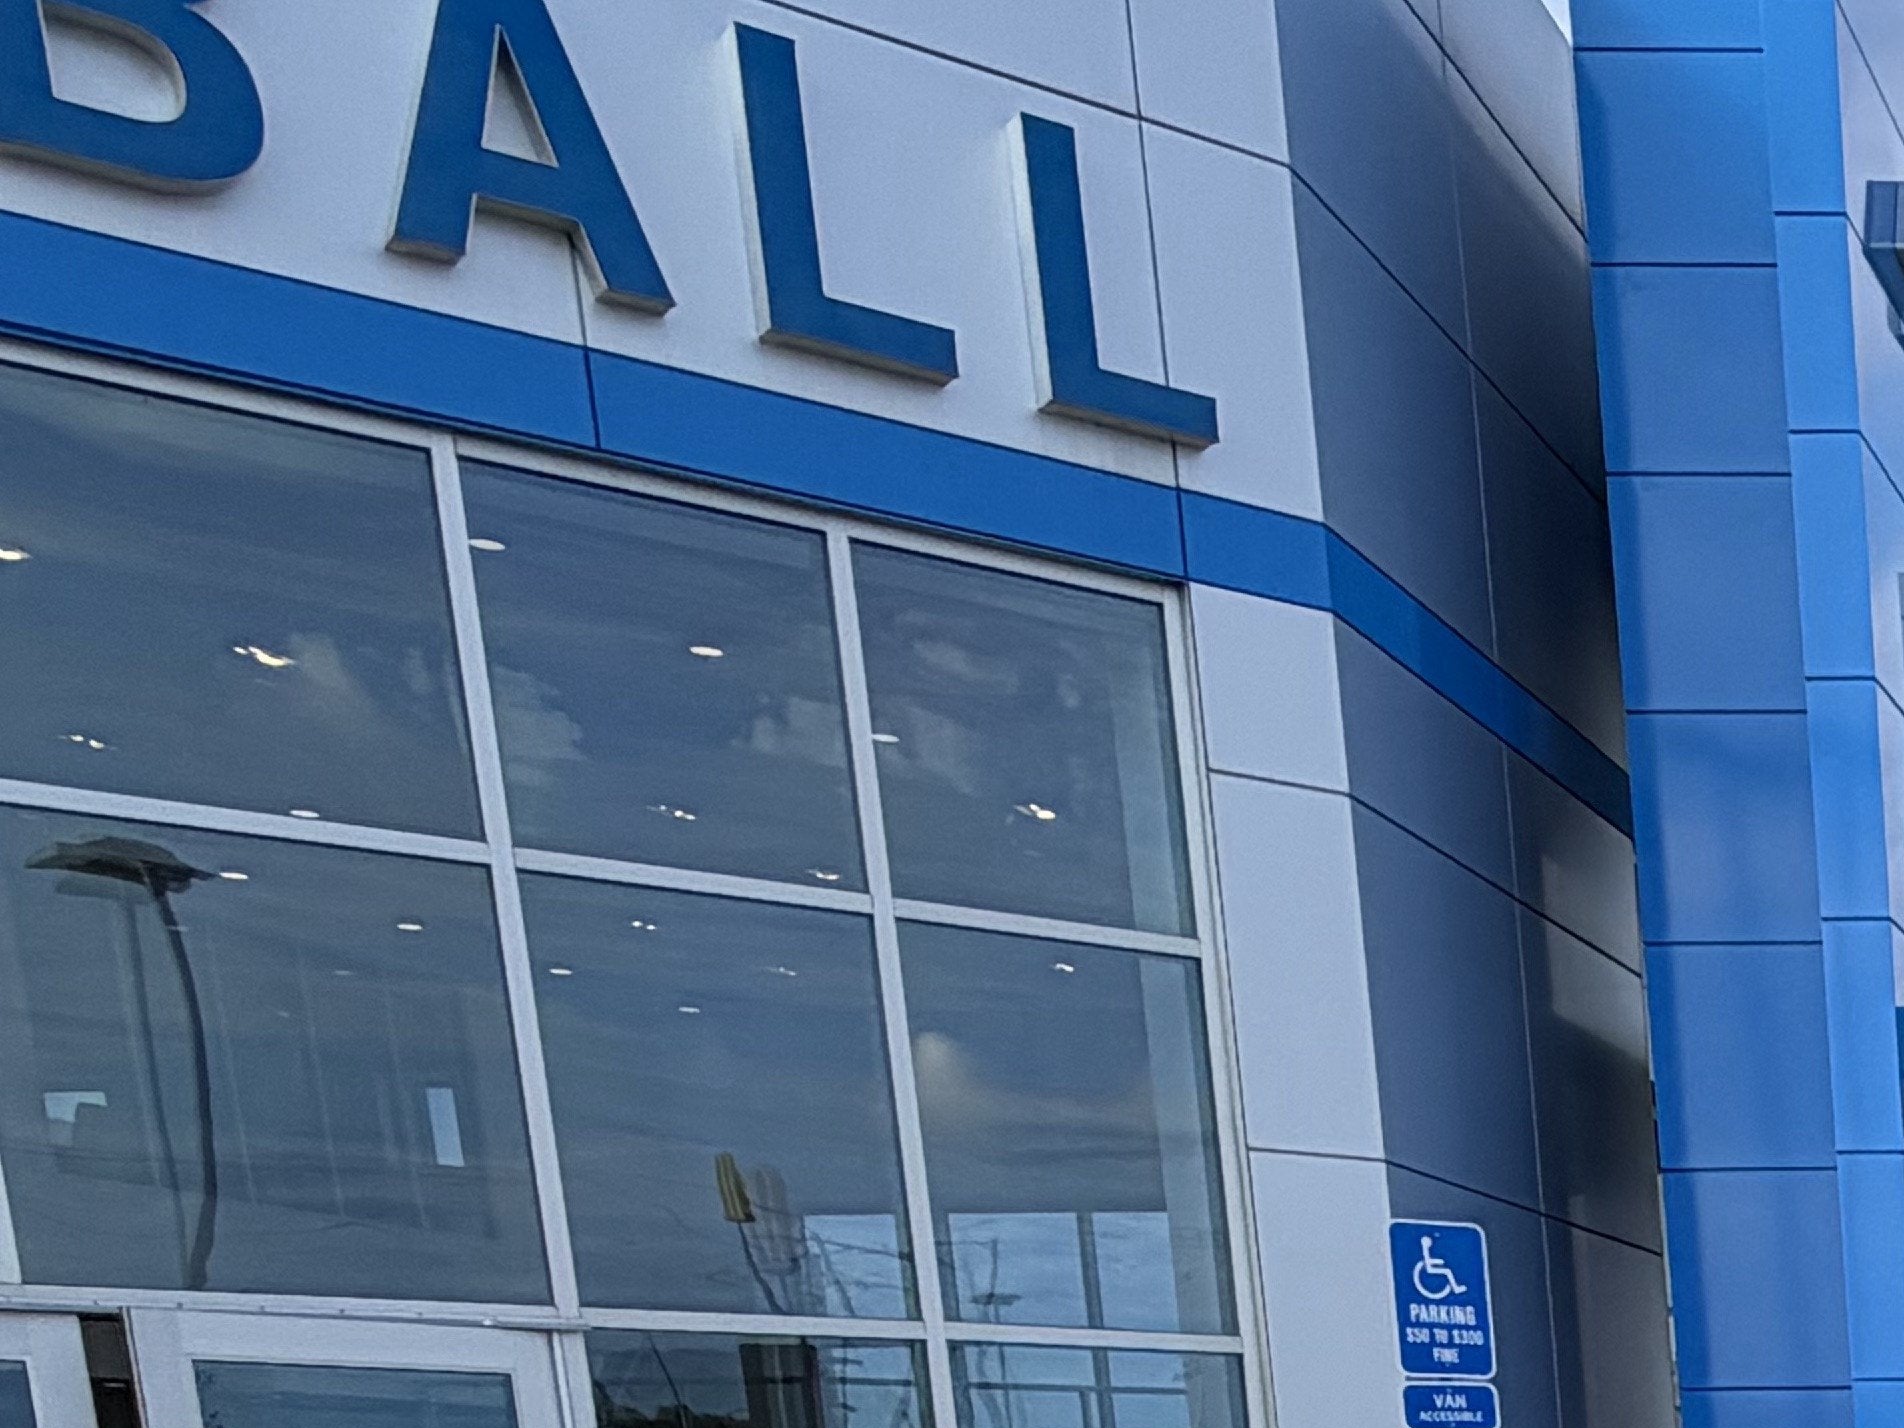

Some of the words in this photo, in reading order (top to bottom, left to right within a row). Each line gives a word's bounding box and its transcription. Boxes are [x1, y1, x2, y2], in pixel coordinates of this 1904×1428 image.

[1409, 1303, 1477, 1326] PARKING
[1433, 1328, 1449, 1344] TO
[1433, 1347, 1460, 1364] FINE
[1432, 1394, 1468, 1409] VAN
[1419, 1410, 1484, 1423] ACCESSIBLE
